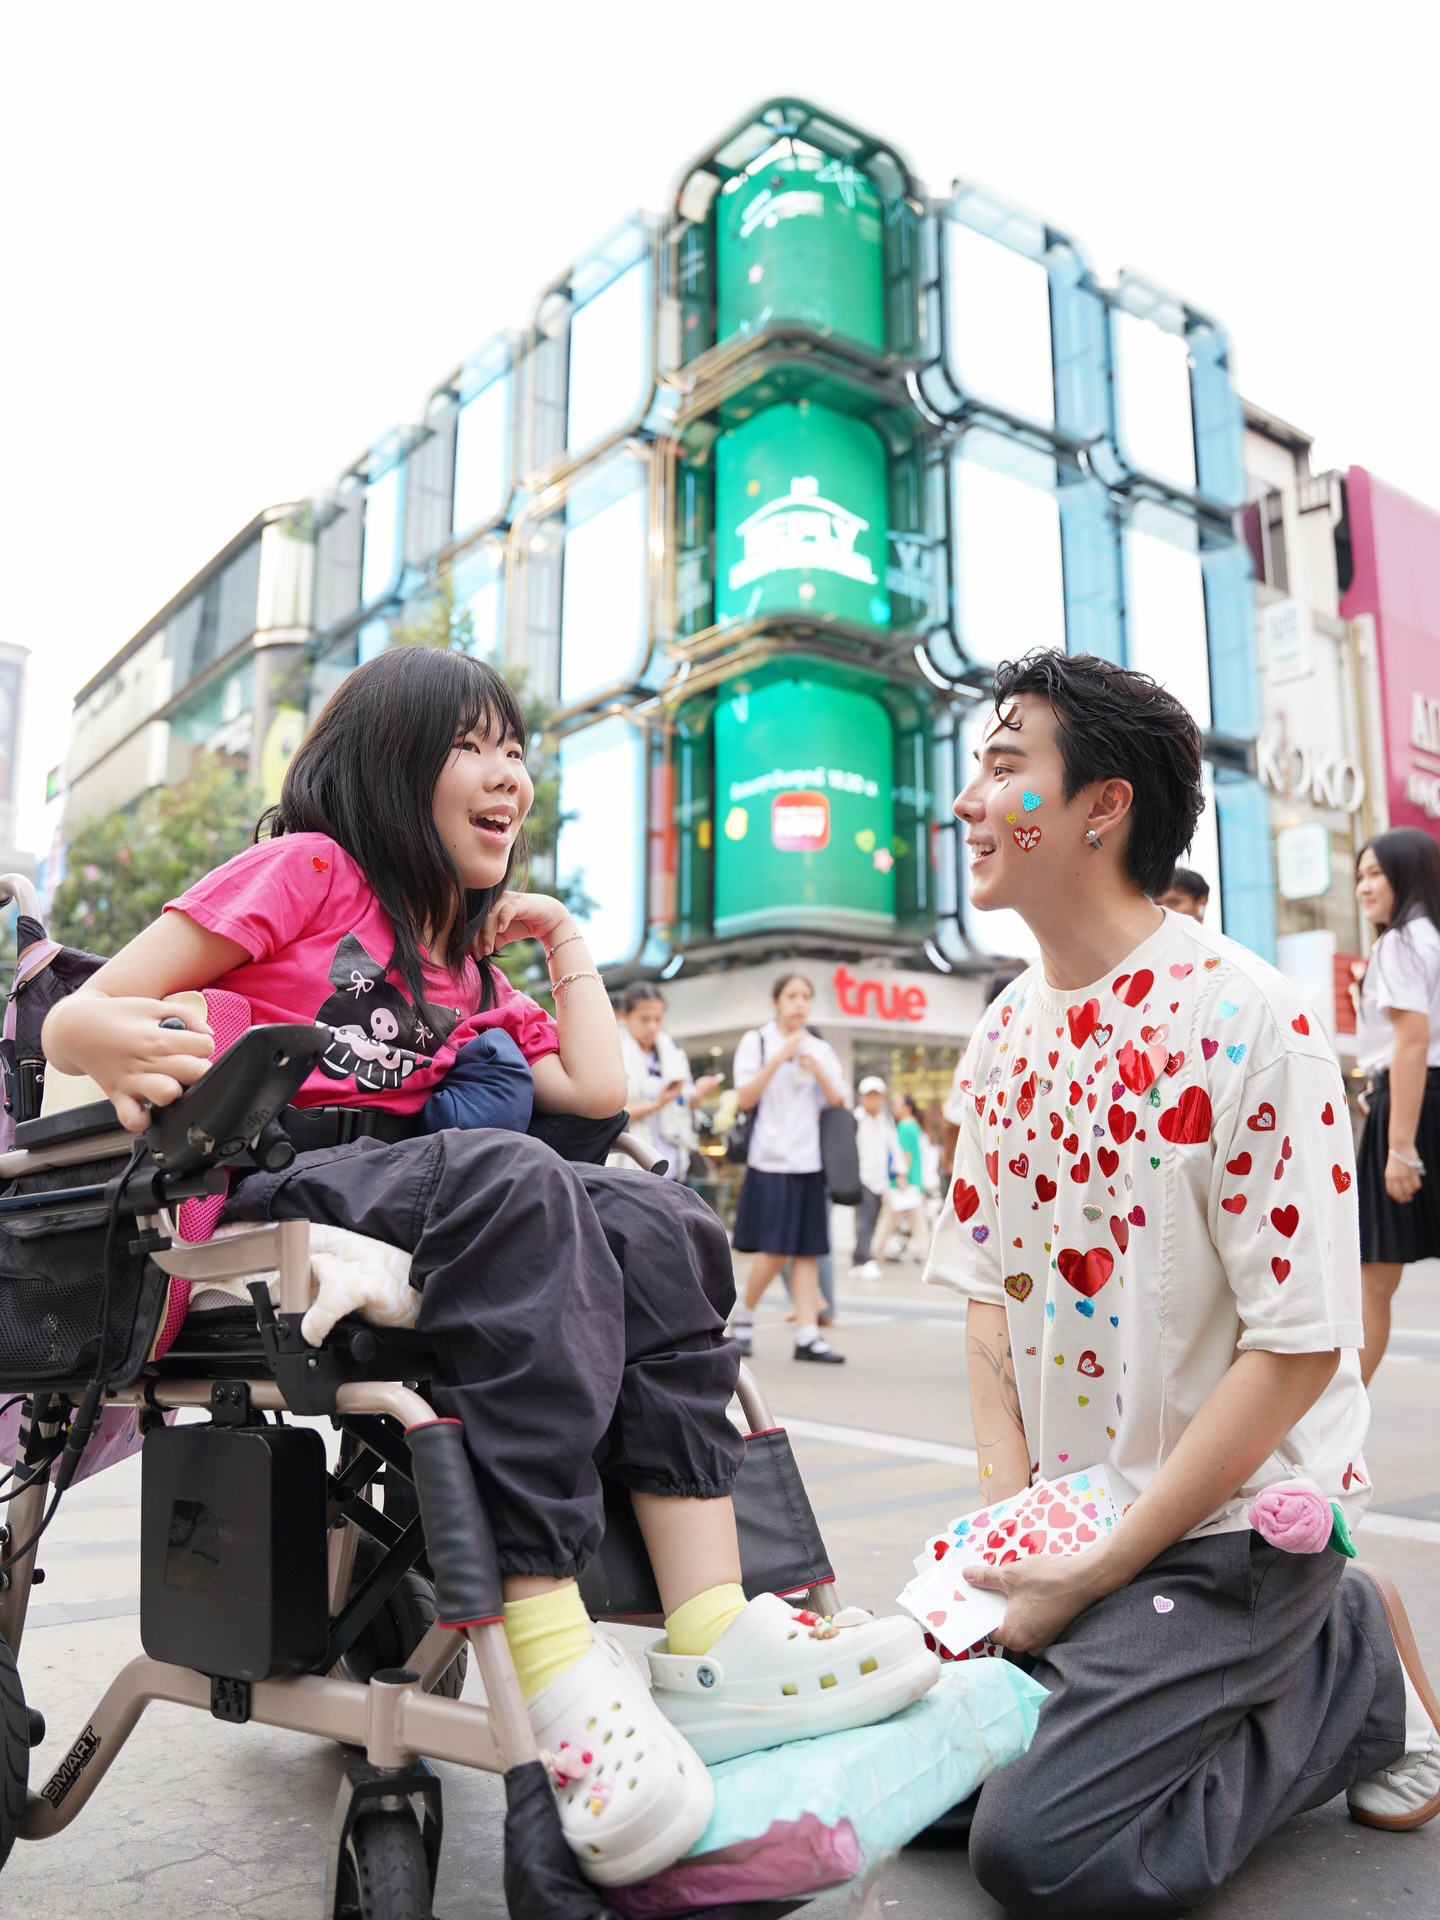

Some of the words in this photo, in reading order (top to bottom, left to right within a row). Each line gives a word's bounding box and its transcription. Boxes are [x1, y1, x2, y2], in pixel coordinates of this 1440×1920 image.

[1256, 735, 1366, 813] KOKO
[832, 964, 928, 1023] true
[41, 1725, 97, 1801] SMART
[52, 1777, 76, 1809] ELECTRIC
